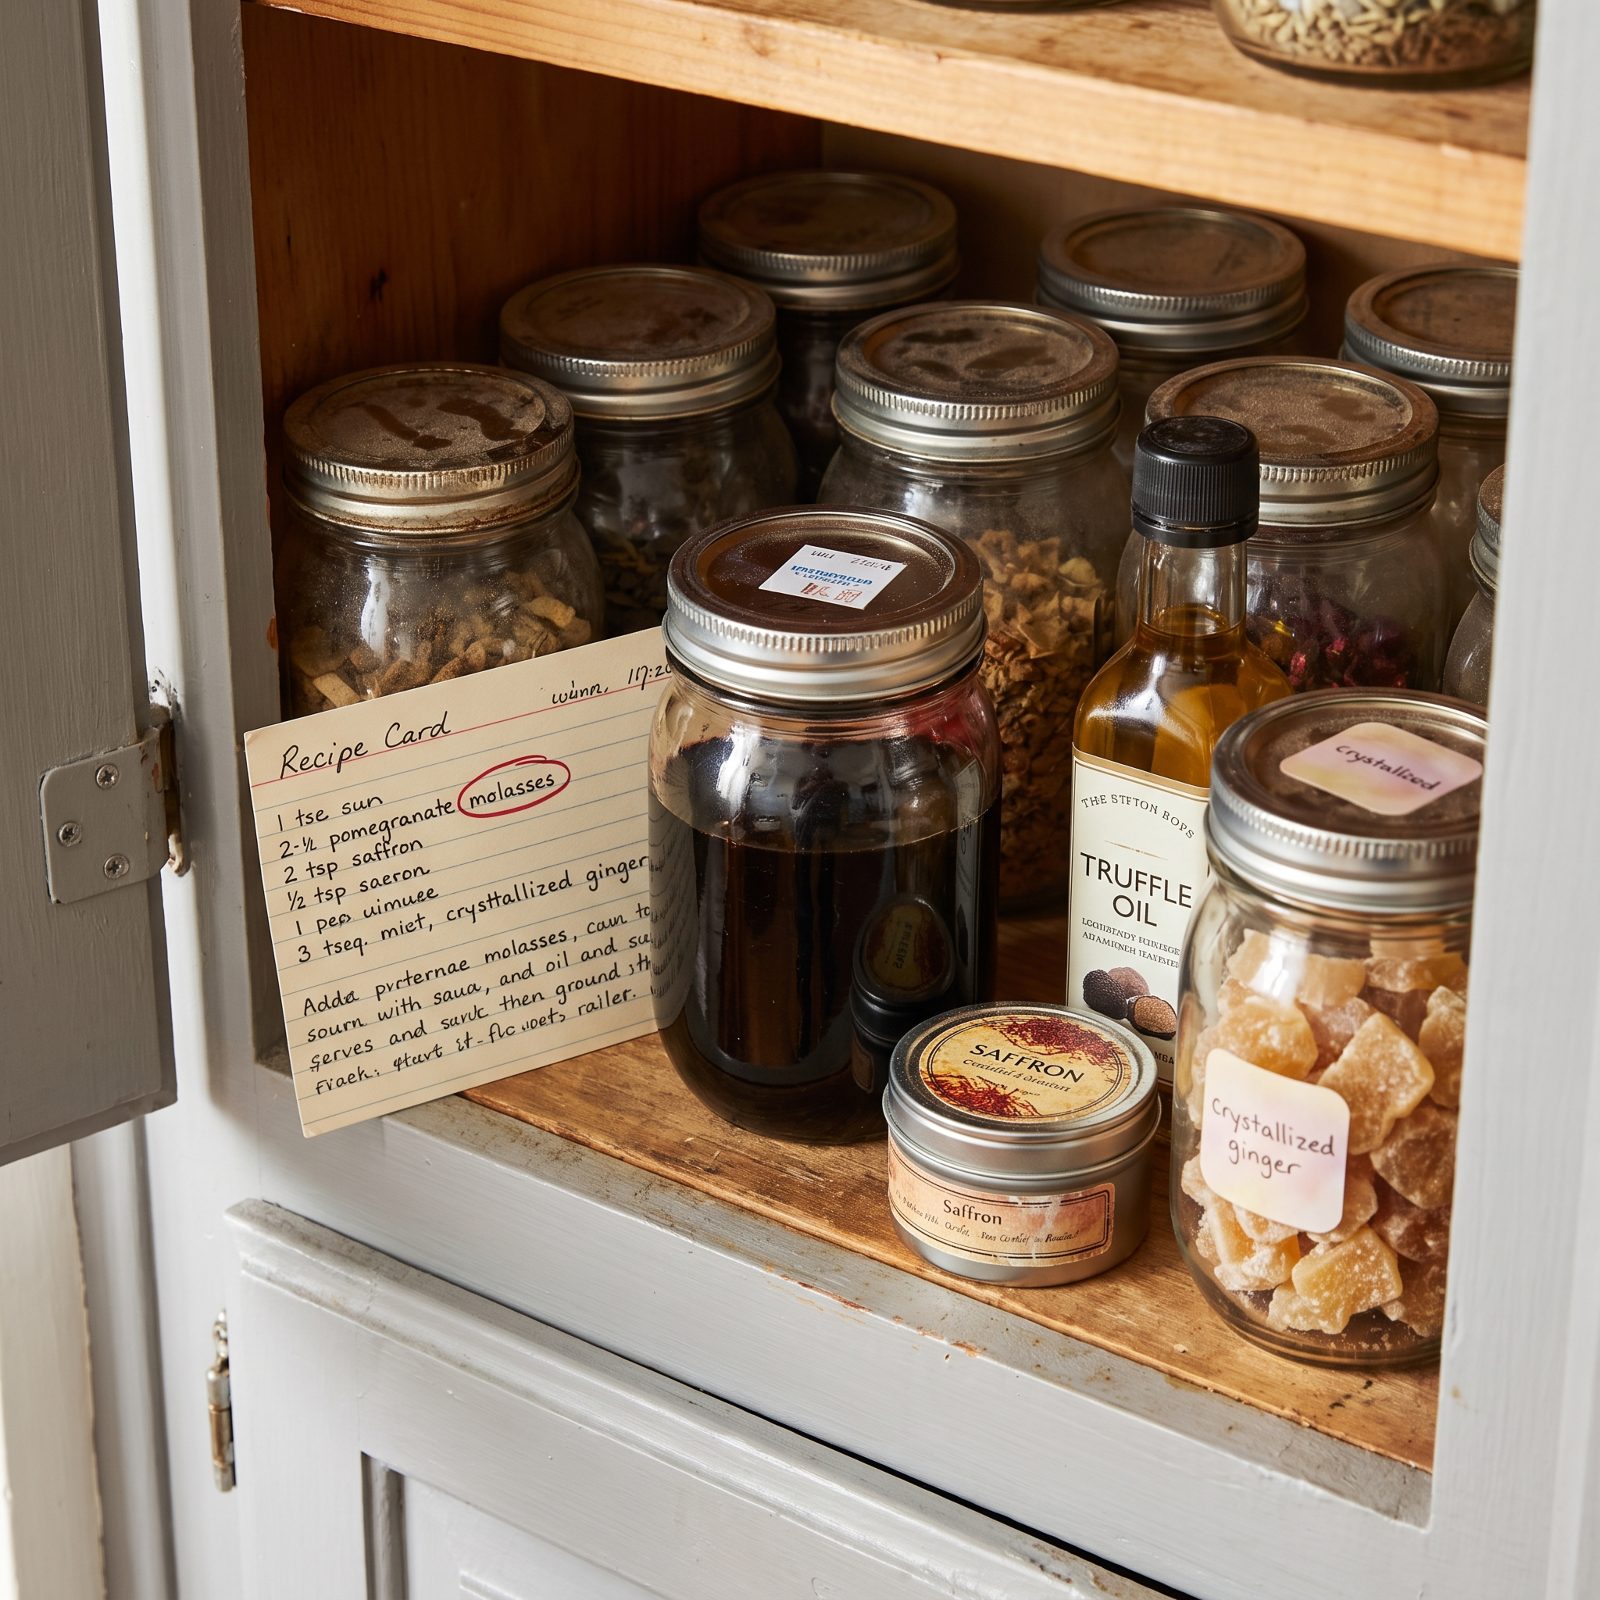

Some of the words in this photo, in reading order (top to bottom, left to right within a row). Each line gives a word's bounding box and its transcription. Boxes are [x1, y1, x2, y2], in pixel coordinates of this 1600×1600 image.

[279, 738, 368, 780] Recipe
[384, 711, 451, 749] Card
[329, 799, 456, 852] pomegranate
[469, 772, 555, 809] molasses
[1081, 795, 1107, 809] THE
[283, 866, 298, 884] 2
[306, 861, 338, 880] tsp
[352, 838, 423, 867] saffron
[1080, 852, 1192, 908] TRUFFLE
[297, 945, 312, 963] 3
[586, 855, 650, 892] ginger
[314, 887, 346, 905] tsp
[1113, 895, 1157, 927] OIL
[377, 996, 422, 1021] with
[499, 962, 535, 987] and
[545, 950, 569, 973] oil
[580, 937, 618, 962] and
[389, 1019, 428, 1046] and
[499, 991, 545, 1012] then
[555, 962, 621, 1005] ground
[969, 1044, 1085, 1083] SAFFRON
[1228, 1139, 1302, 1179] ginger
[944, 1199, 1002, 1225] Saffron
